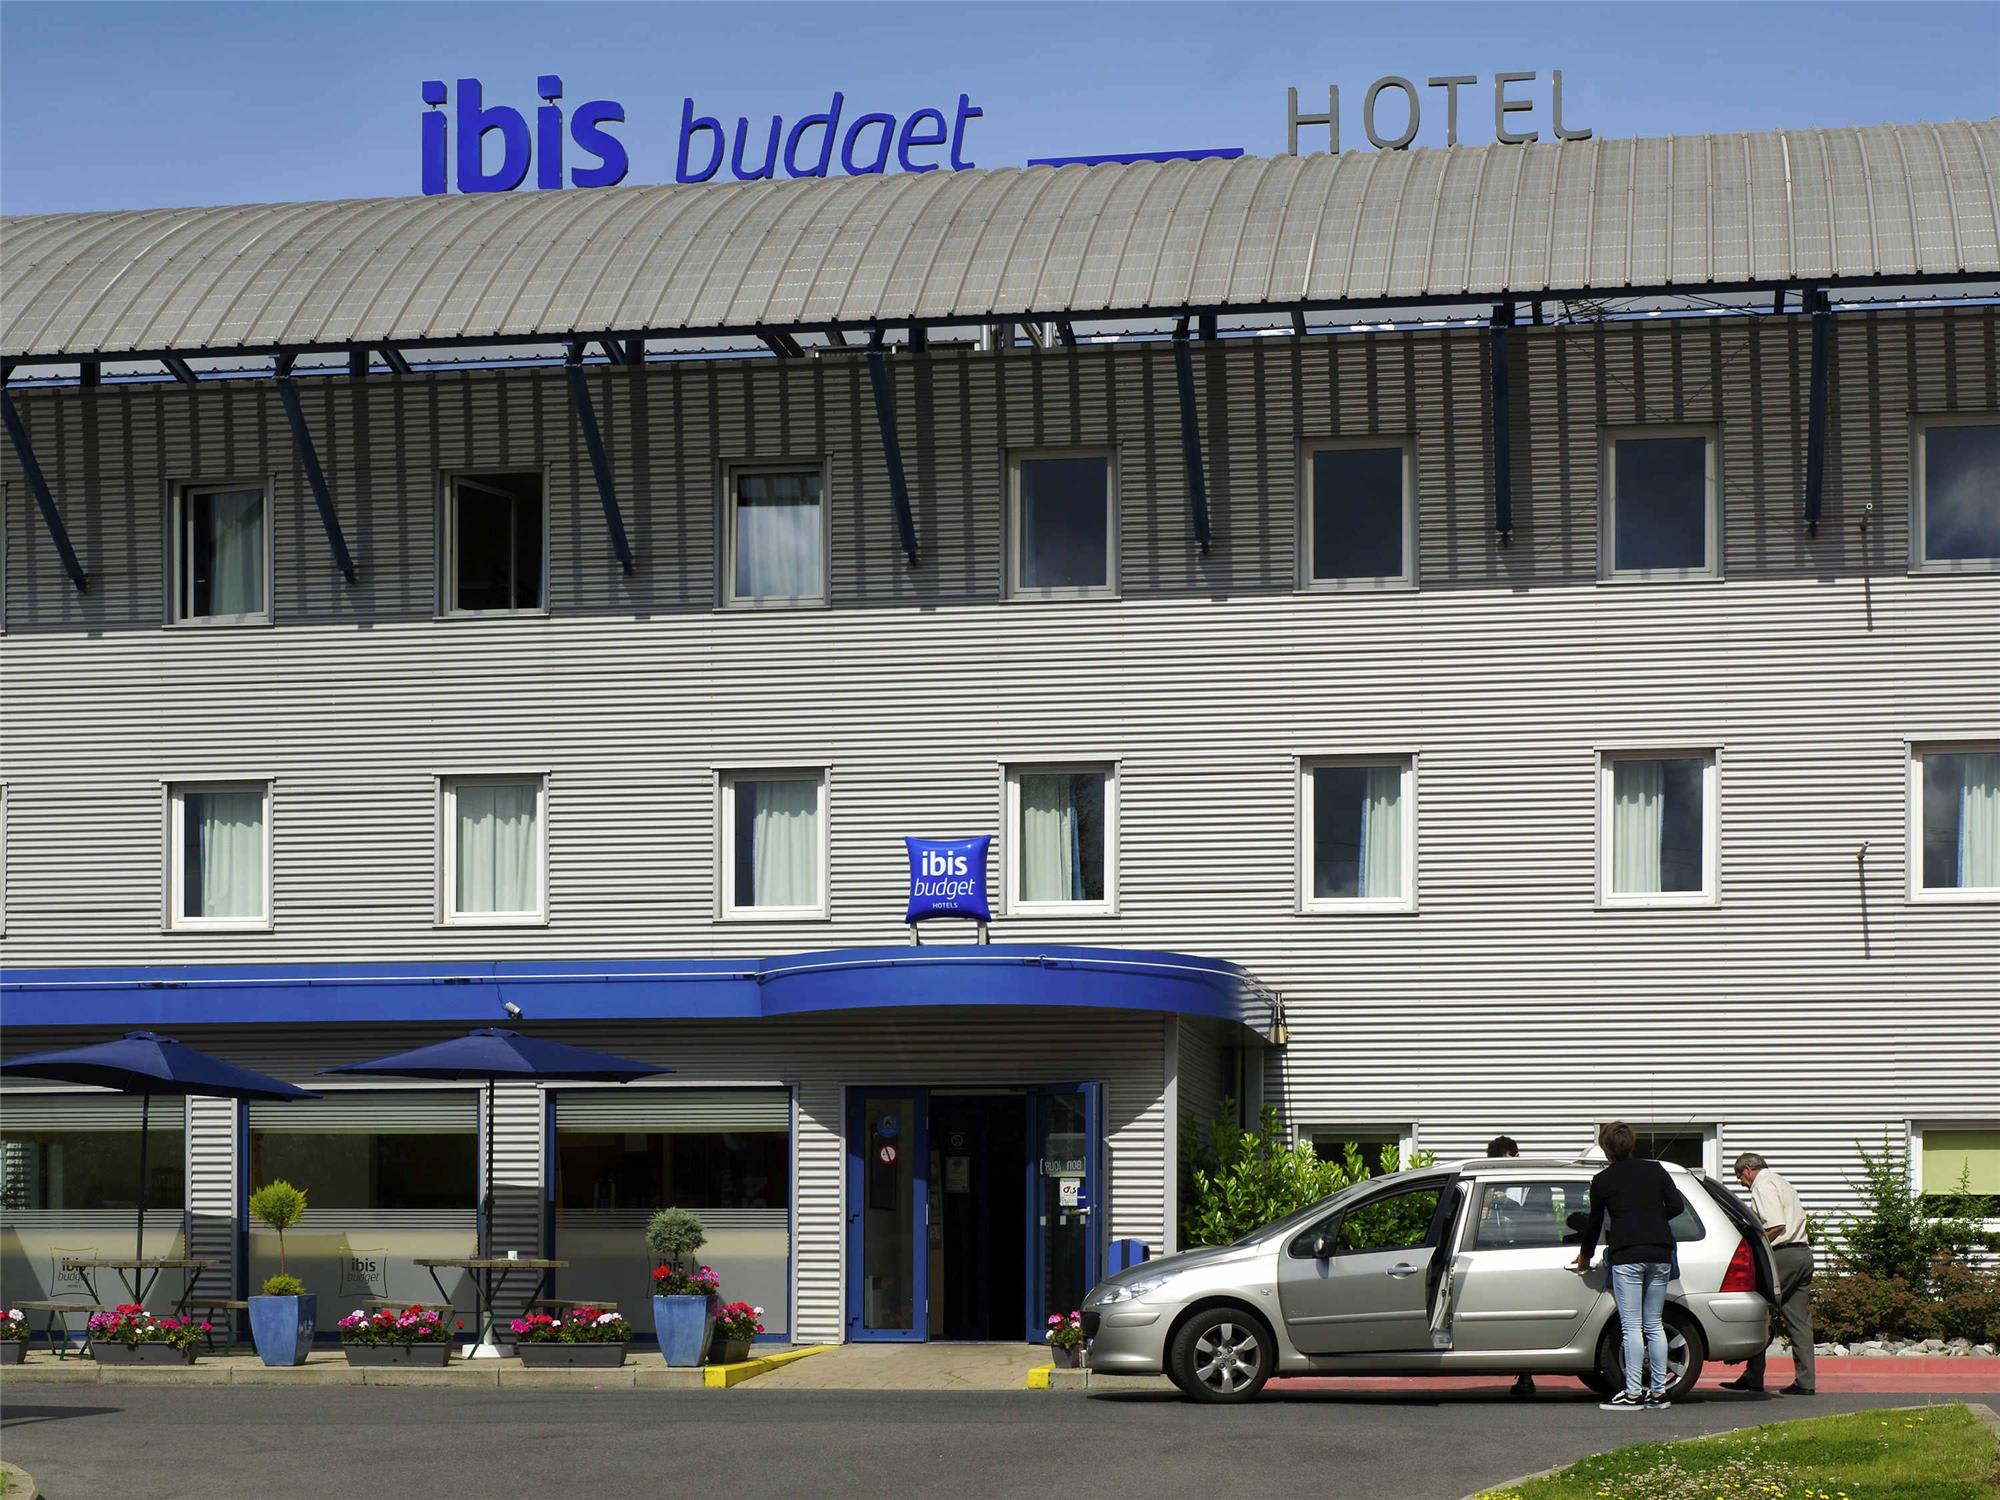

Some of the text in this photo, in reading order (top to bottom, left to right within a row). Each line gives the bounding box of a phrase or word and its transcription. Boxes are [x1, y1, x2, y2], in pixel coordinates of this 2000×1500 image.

[1287, 69, 1593, 157] HOTEL
[422, 75, 628, 196] ibis
[922, 850, 968, 876] ibis
[914, 877, 975, 900] budget
[351, 1257, 376, 1272] ibis
[57, 1271, 91, 1284] budgt
[346, 1271, 379, 1285] budget
